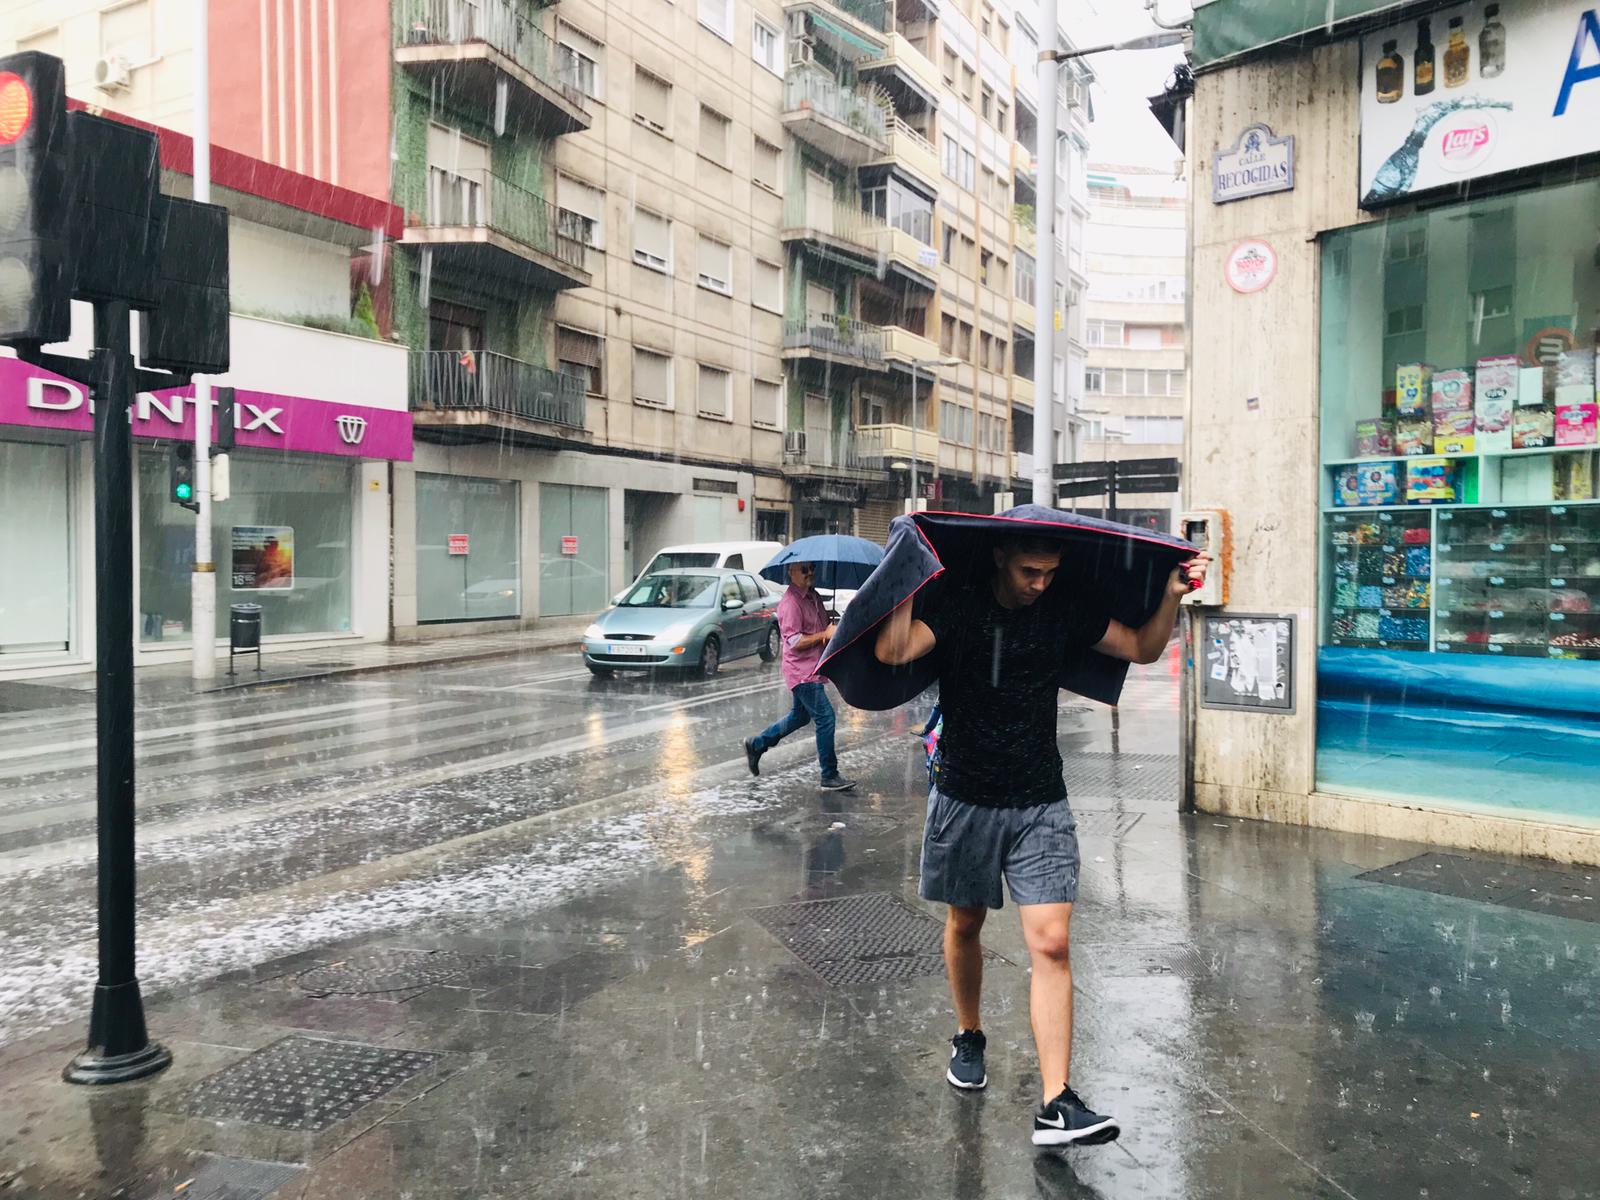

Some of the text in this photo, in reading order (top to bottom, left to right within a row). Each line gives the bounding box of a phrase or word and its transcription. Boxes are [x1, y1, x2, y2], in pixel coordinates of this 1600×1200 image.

[1552, 8, 1600, 117] A
[1218, 161, 1288, 190] RECOGIDAS
[1239, 152, 1266, 166] CALLE
[26, 376, 286, 434] DNIX
